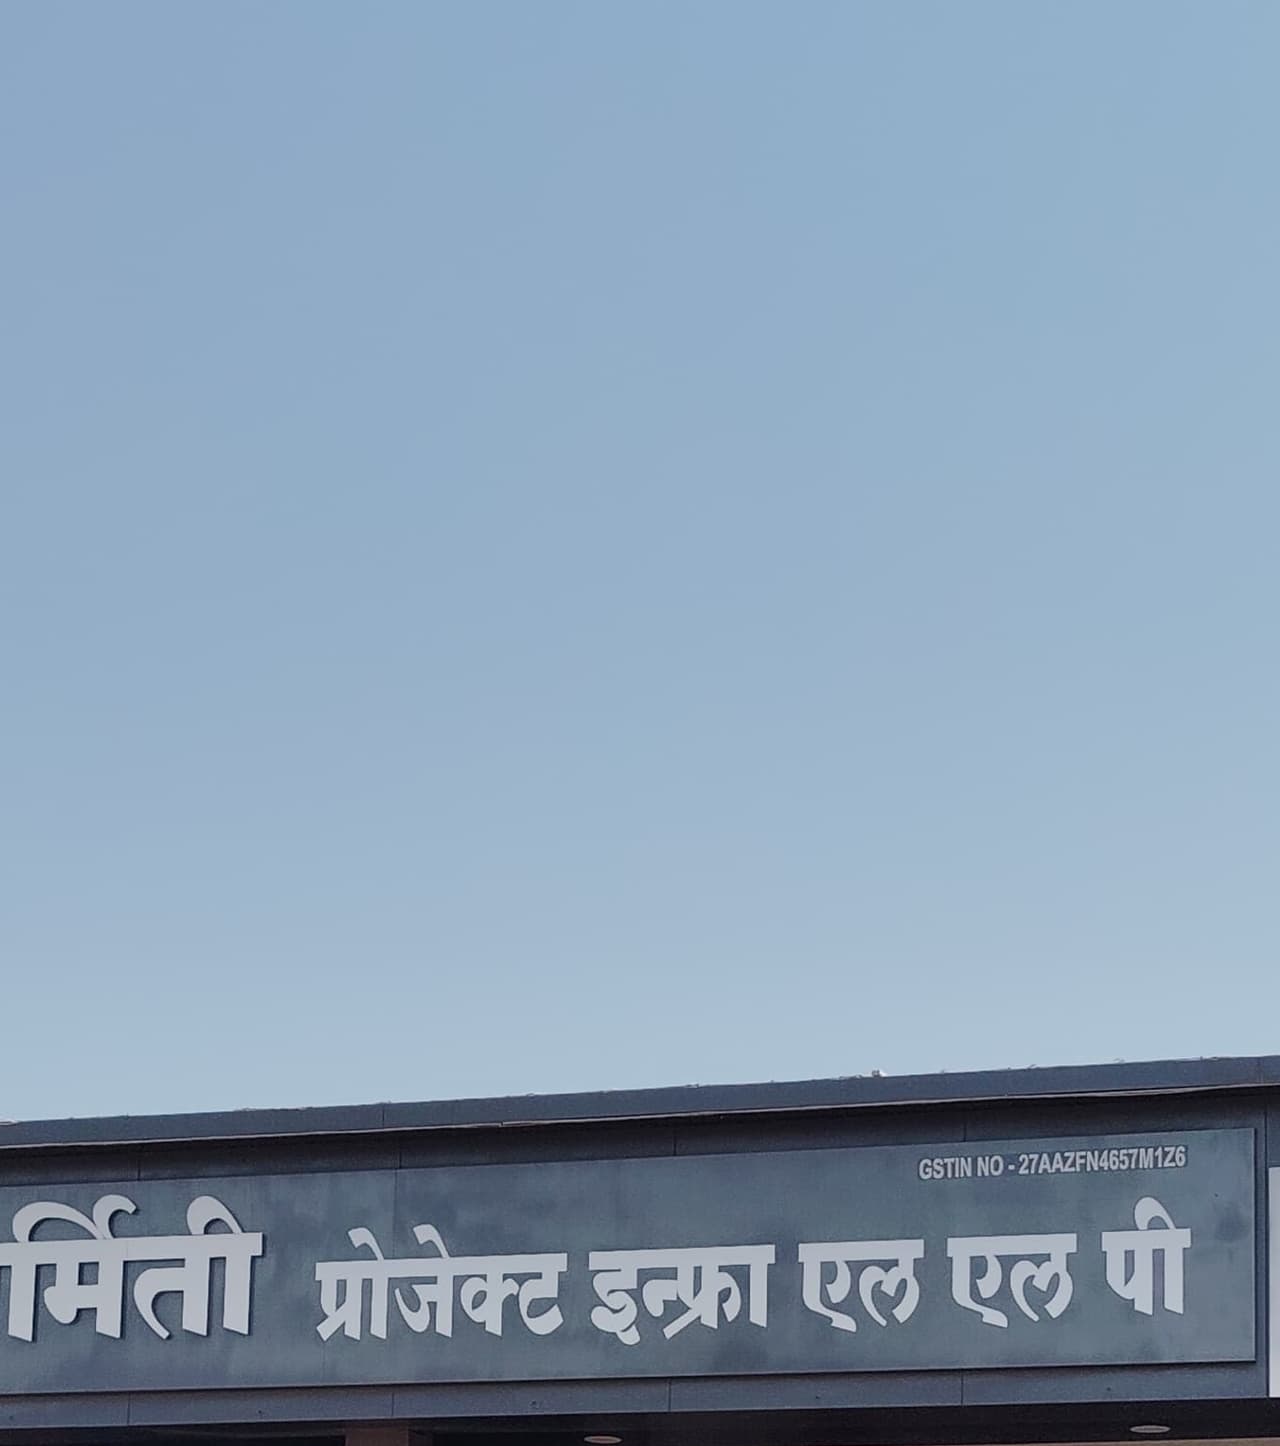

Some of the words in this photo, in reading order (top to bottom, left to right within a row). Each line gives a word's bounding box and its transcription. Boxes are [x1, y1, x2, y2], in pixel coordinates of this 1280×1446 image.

[918, 1157, 971, 1180] GSTIN
[977, 1155, 1004, 1177] NO
[1018, 1145, 1186, 1175] 27AAZFN4657M1Z6
[315, 1225, 568, 1342] प्रोजेक्ट
[588, 1244, 776, 1346] इन्फ्रा
[798, 1238, 925, 1333] एल
[946, 1233, 1078, 1328] एल
[1101, 1196, 1192, 1316] पी
